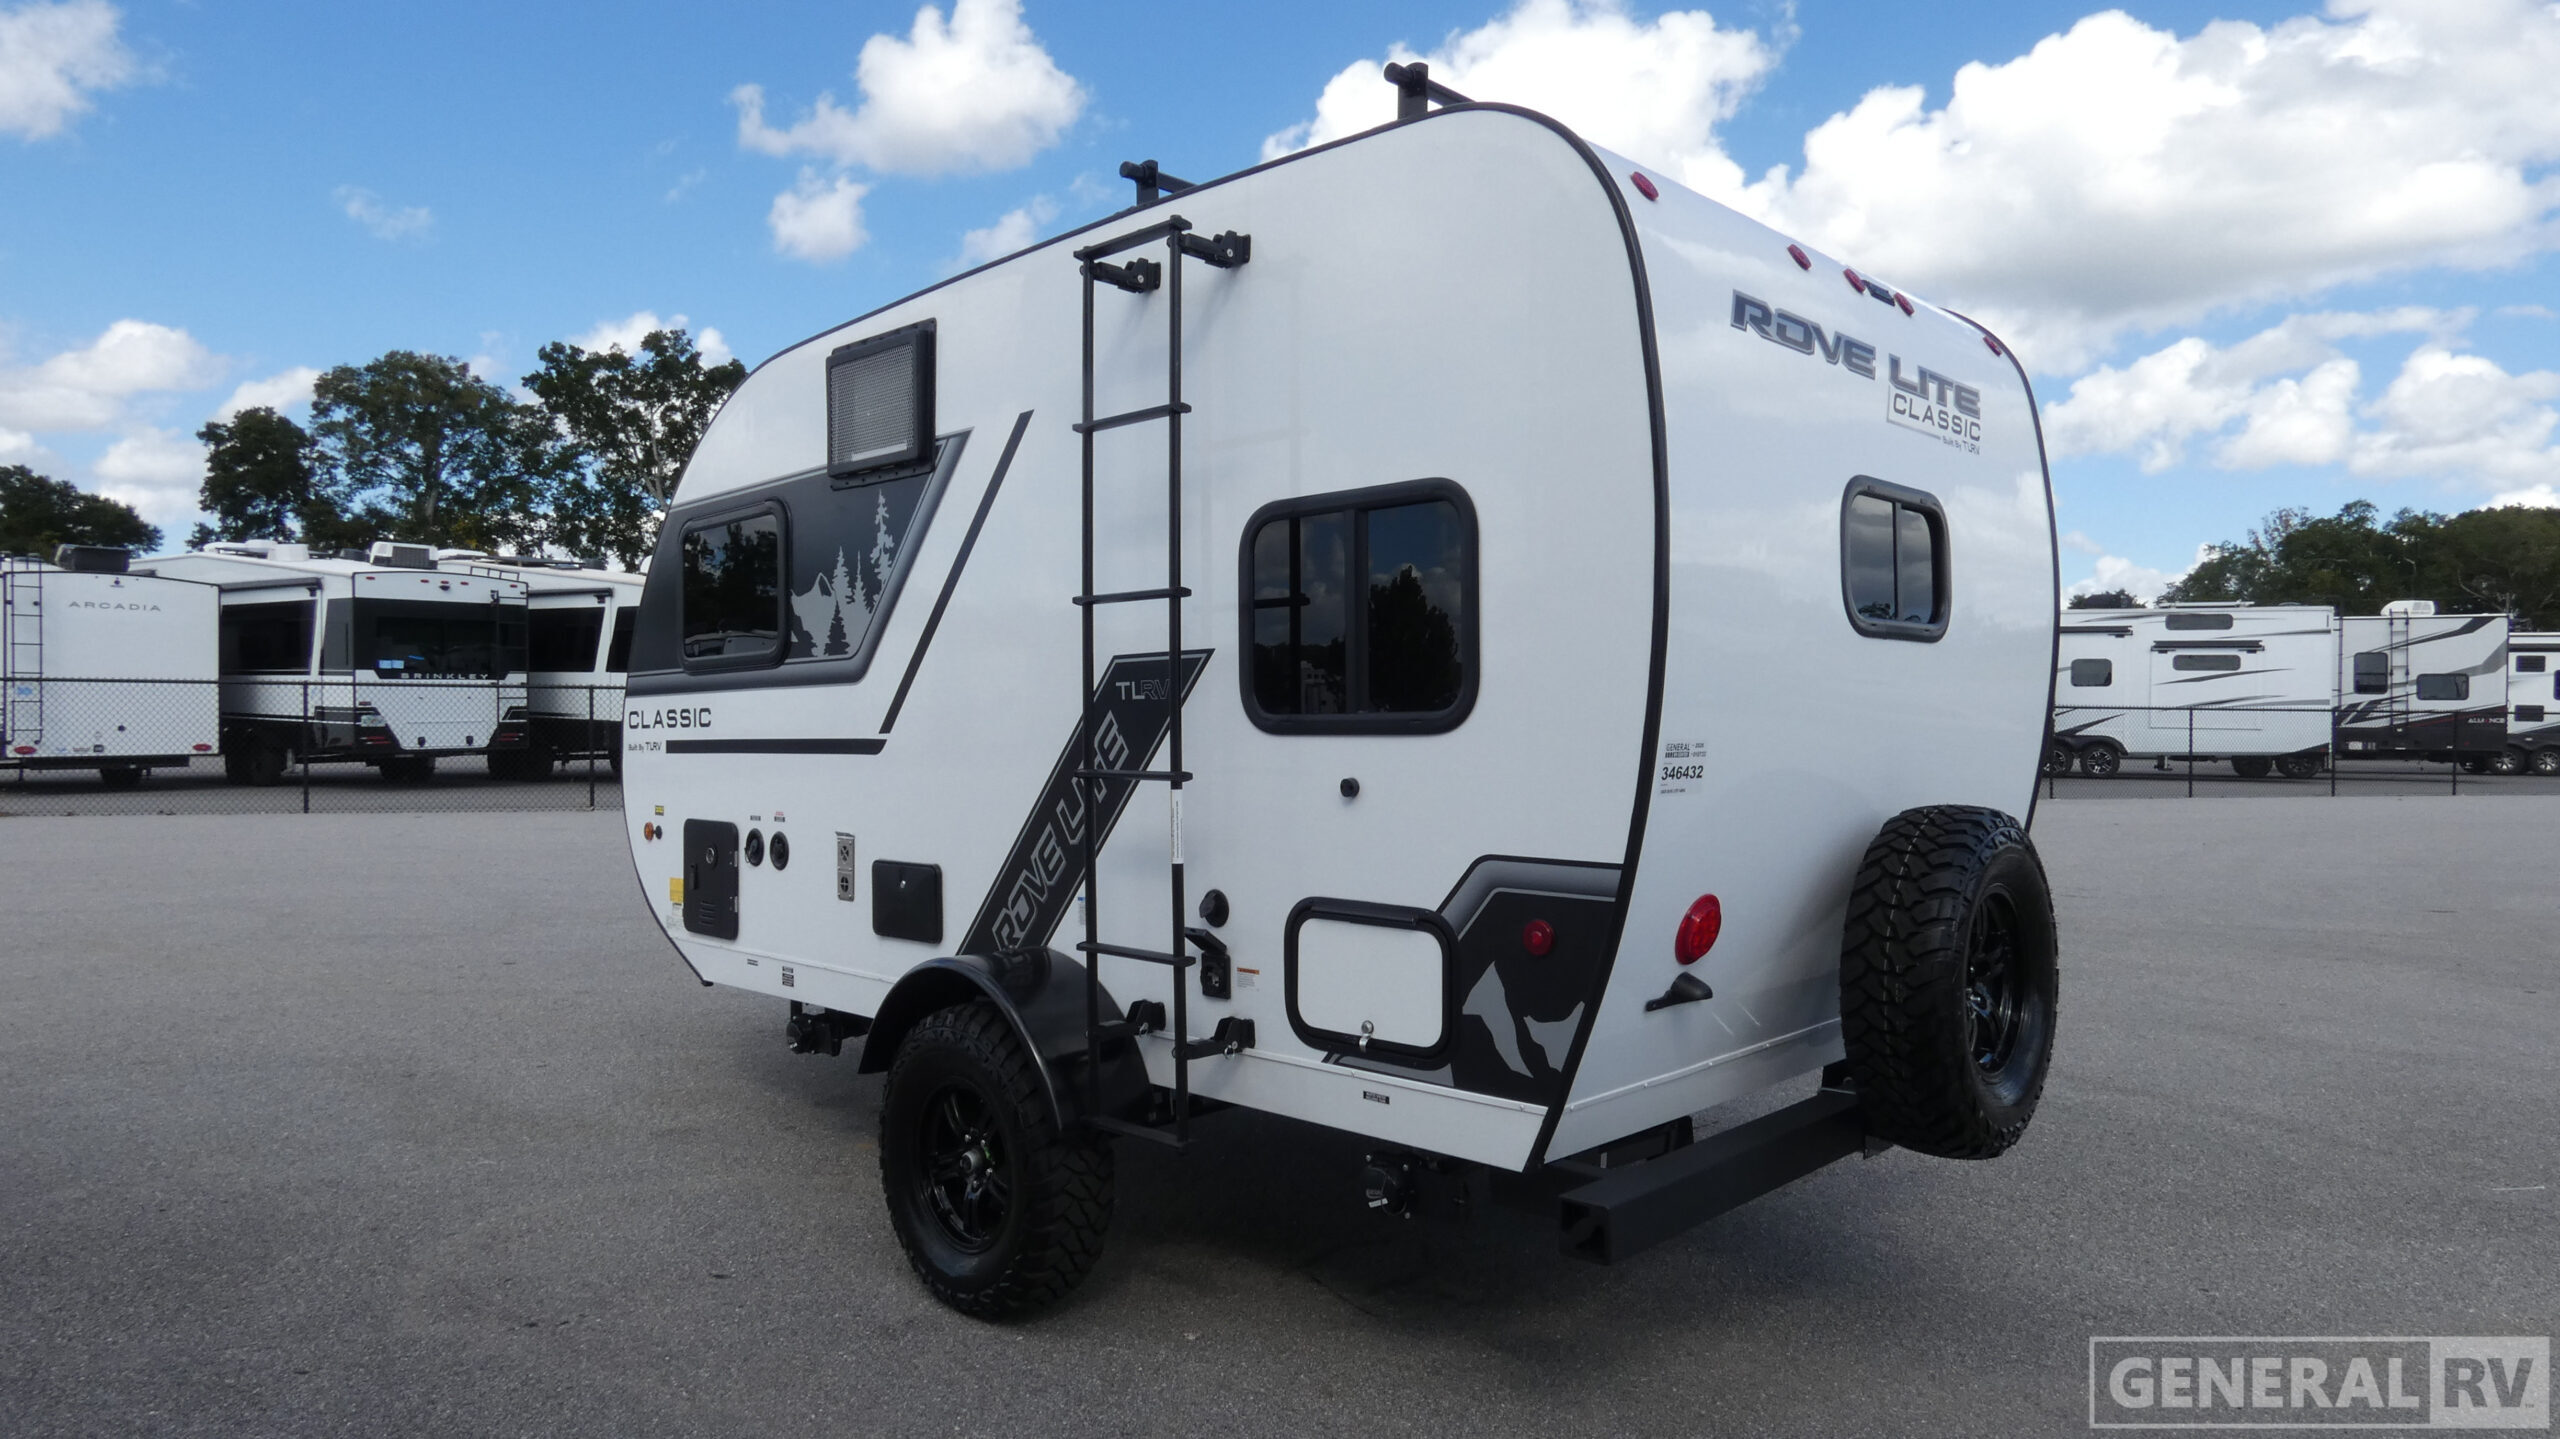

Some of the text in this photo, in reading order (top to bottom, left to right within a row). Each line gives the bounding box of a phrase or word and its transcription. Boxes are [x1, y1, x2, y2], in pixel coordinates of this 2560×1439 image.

[1731, 289, 1981, 420] ROVE LITE
[1893, 392, 1981, 442] CLASSIC
[68, 601, 161, 612] ARCADIA
[400, 672, 489, 680] BRINKLEY
[1115, 680, 1170, 700] TLRV
[628, 707, 712, 730] CLASSIC
[1665, 743, 1690, 751] GENERAL
[1661, 765, 1704, 780] 346432
[992, 822, 1067, 951] ROVE
